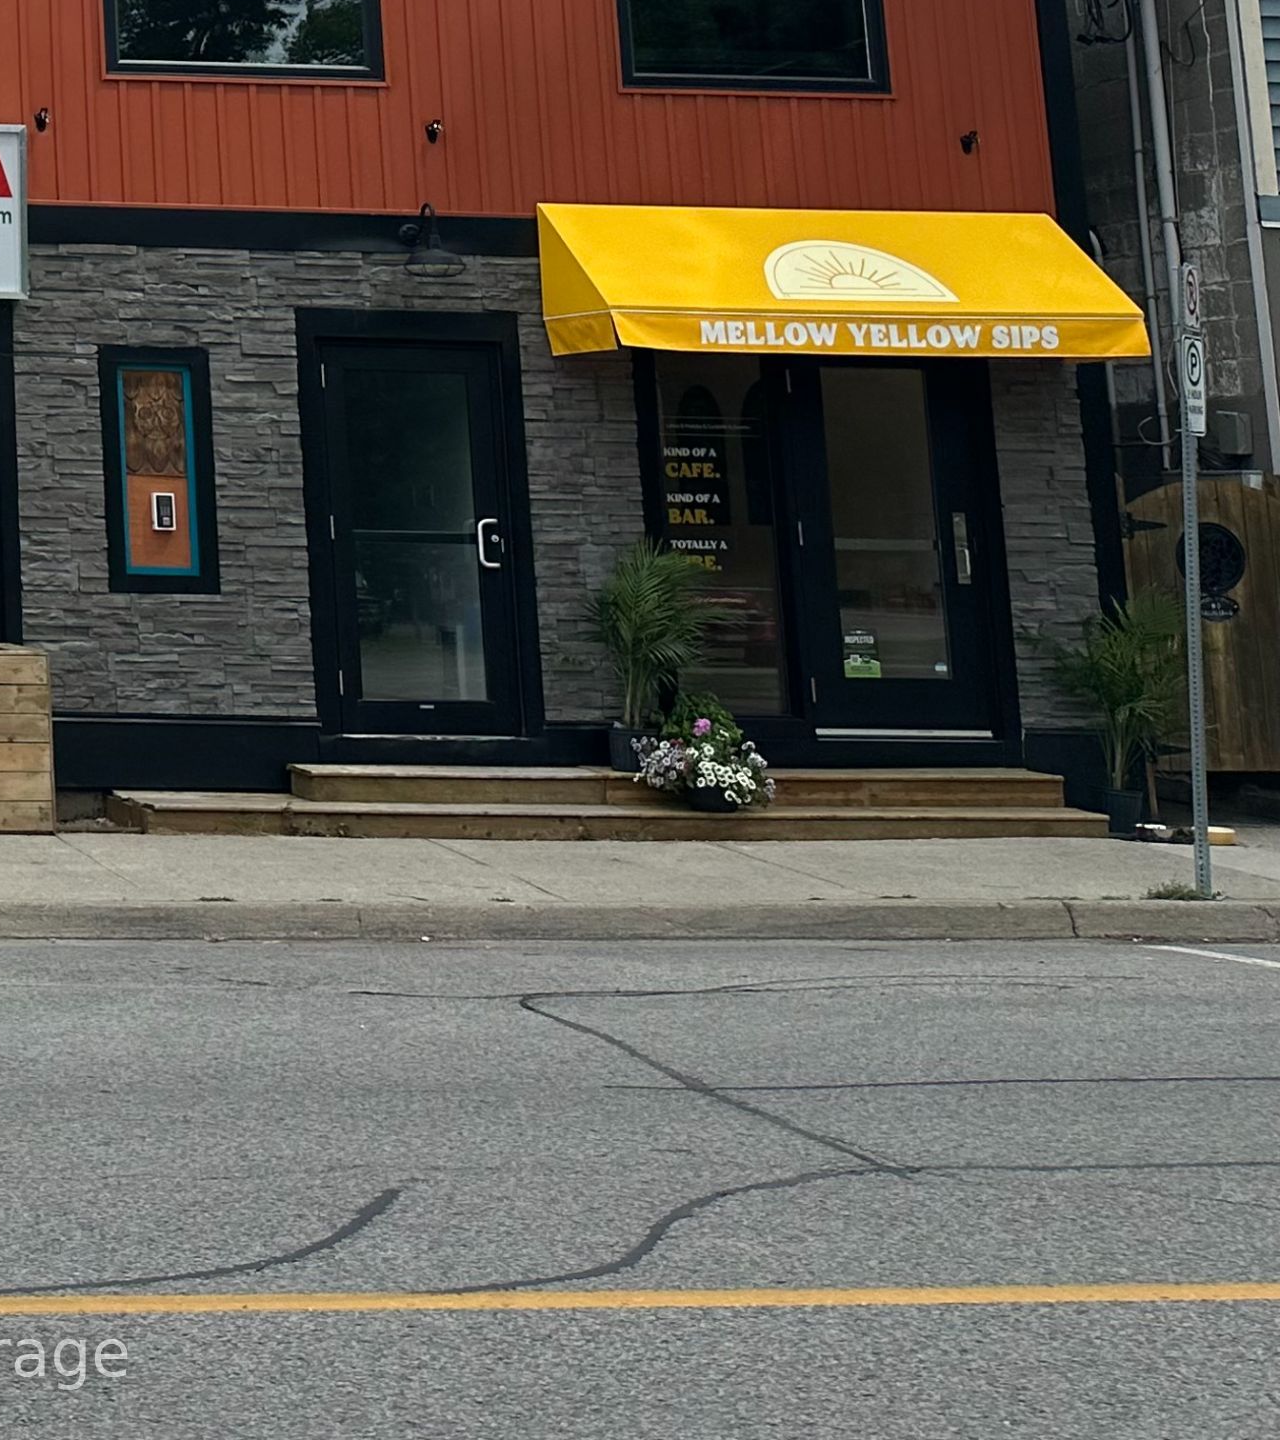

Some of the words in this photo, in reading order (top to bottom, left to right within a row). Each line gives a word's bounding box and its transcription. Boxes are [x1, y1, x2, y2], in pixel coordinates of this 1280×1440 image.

[700, 320, 838, 347] MELLOW
[847, 323, 981, 349] YELLOW
[992, 325, 1059, 350] SIPS
[663, 447, 690, 457] KIND
[692, 447, 707, 457] OF
[709, 447, 717, 457] A
[665, 462, 721, 479] CAFE.
[667, 493, 694, 503] KIND
[695, 493, 710, 503] OF
[712, 493, 720, 503] A
[668, 508, 715, 525] BAR.
[670, 539, 718, 550] TOTALLY
[720, 540, 728, 550] A
